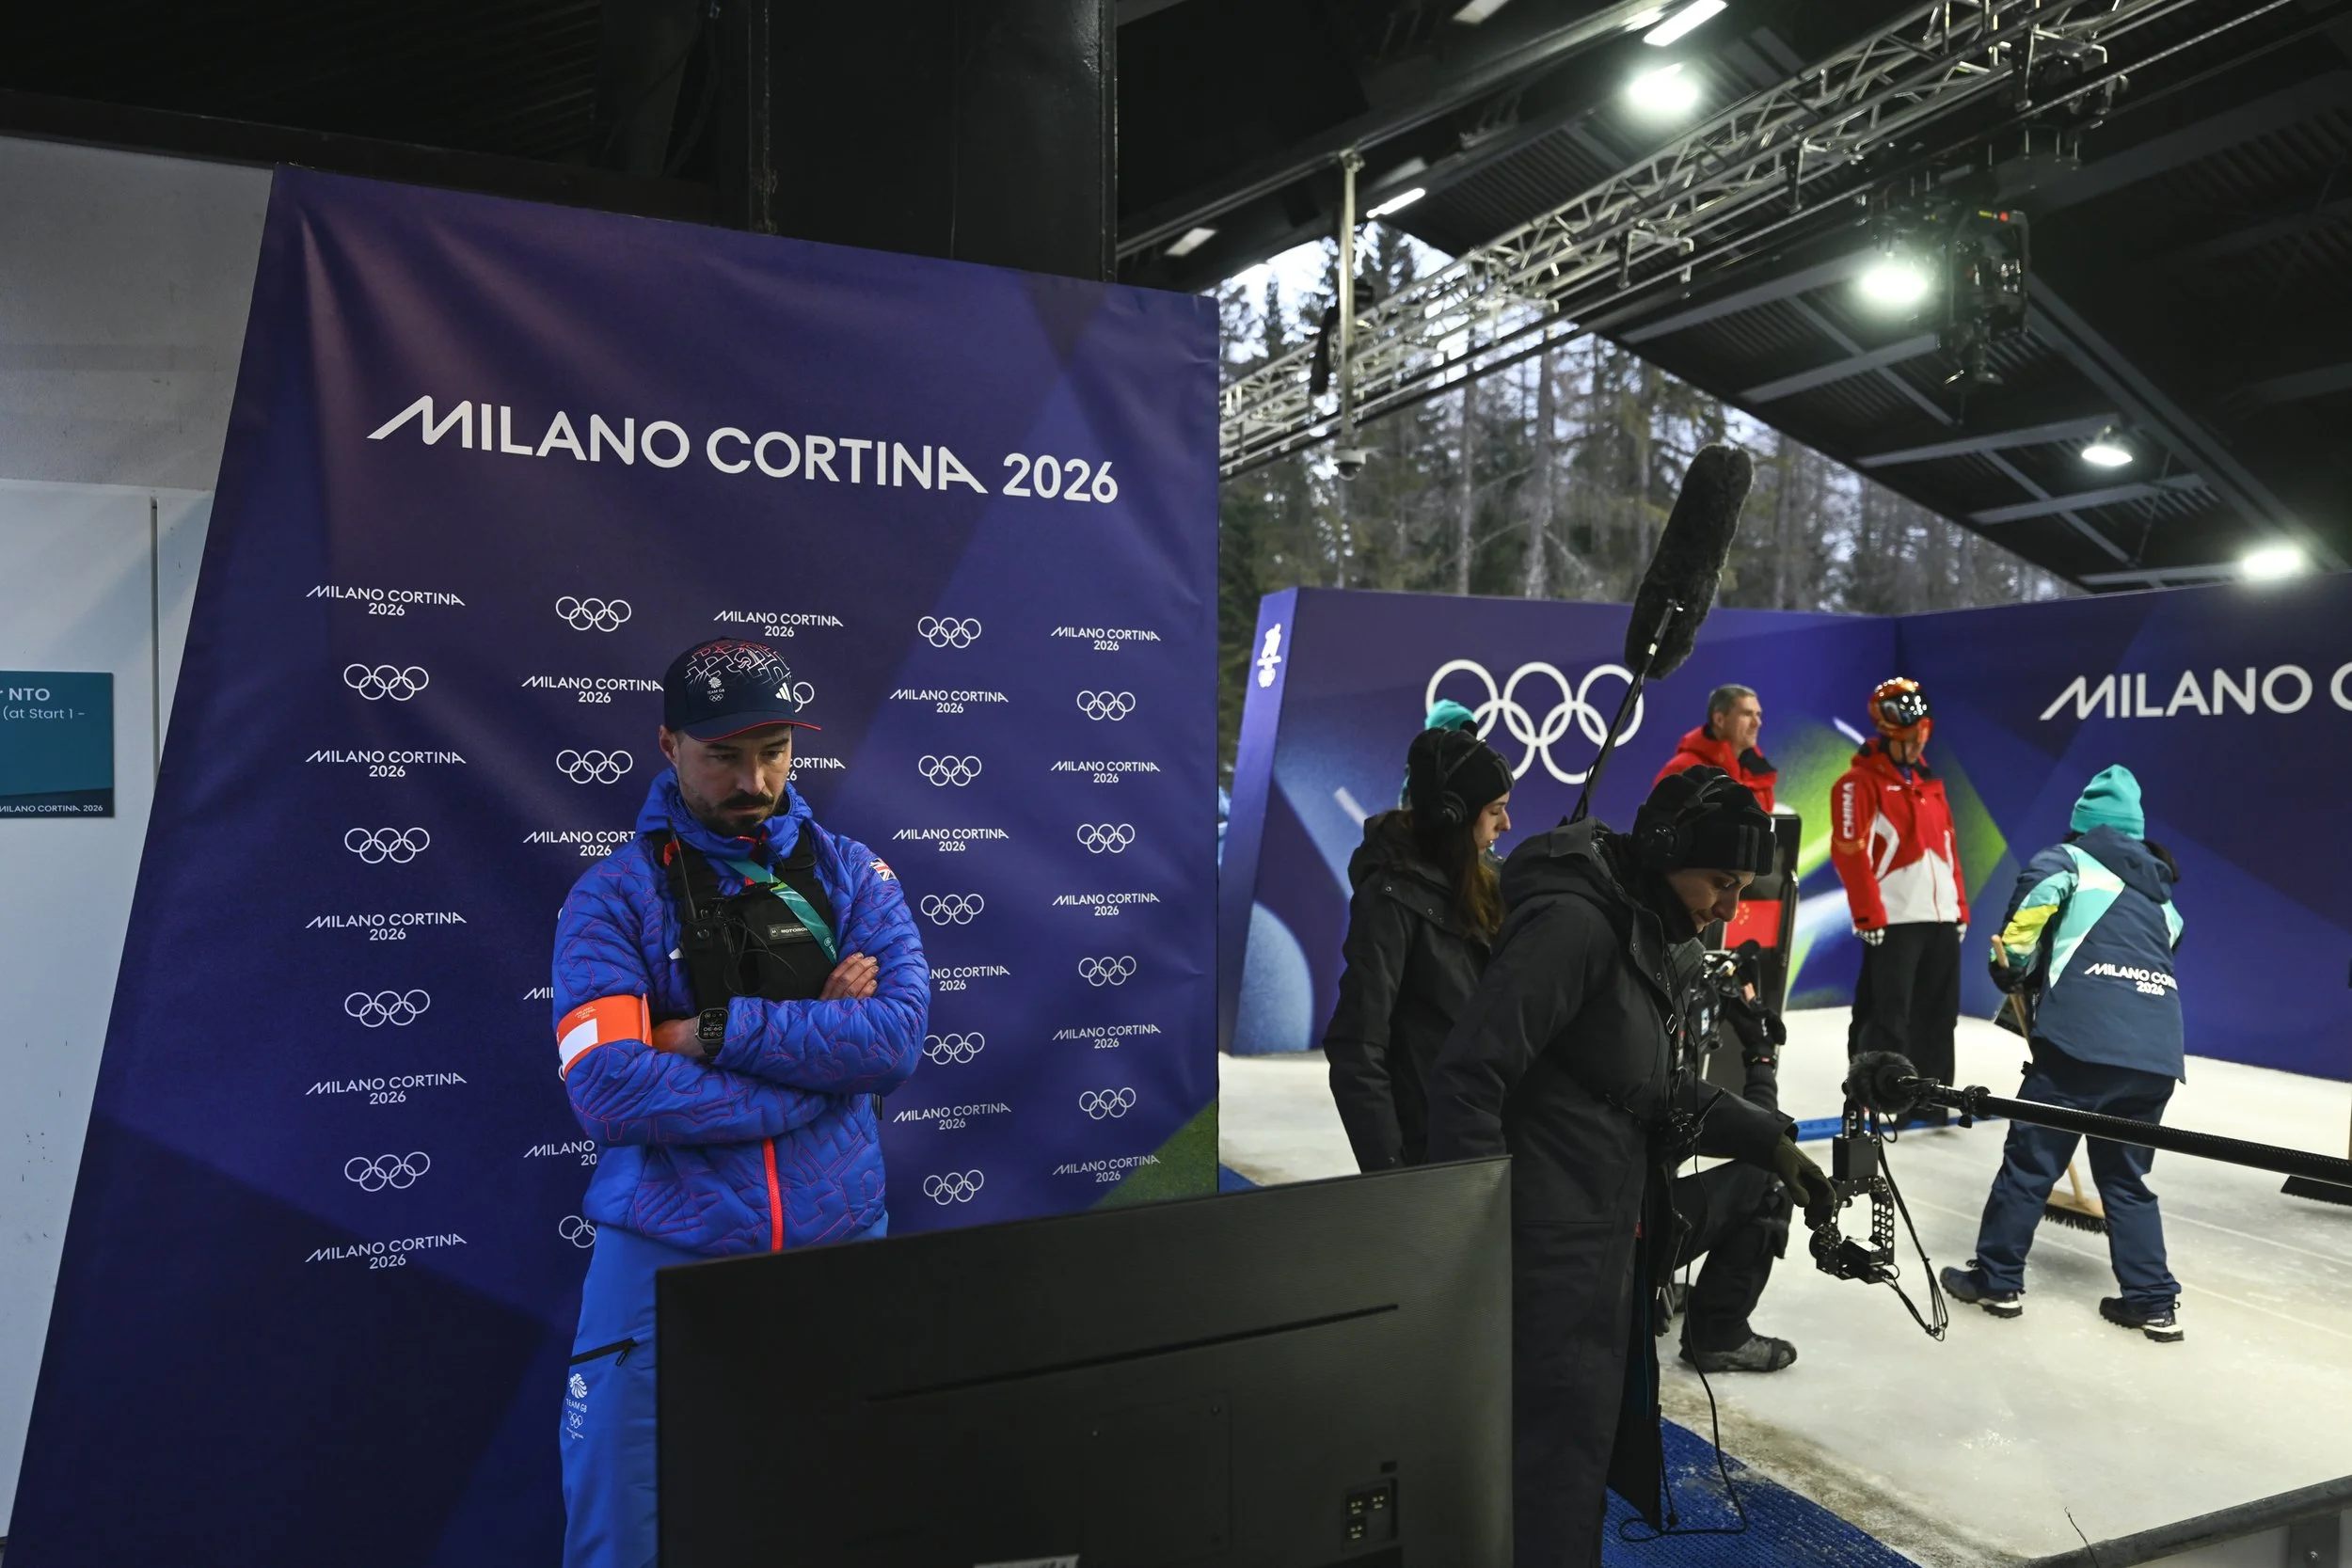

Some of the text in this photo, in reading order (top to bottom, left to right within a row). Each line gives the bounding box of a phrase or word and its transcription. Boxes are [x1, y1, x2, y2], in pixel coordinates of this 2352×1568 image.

[367, 395, 1119, 504] MILANO CORTINA 2026
[305, 585, 466, 607] MILANO CORTINA
[368, 602, 405, 617] 2026
[713, 610, 844, 627] MILANO CORTINA
[764, 625, 795, 638] 2026
[1050, 626, 1162, 641] MILANO CORTINA
[1093, 639, 1120, 652] 2026
[521, 675, 664, 692] MILANO CORTINA
[8, 688, 51, 702] NTO
[578, 690, 612, 704] 2026
[889, 689, 1009, 704] MILANO CORTINA
[2040, 664, 2313, 721] MILANO
[3, 705, 24, 721] (at
[29, 708, 64, 719] Start
[69, 708, 73, 719] 1
[936, 702, 964, 714] 2026
[305, 750, 467, 765] MILANO CORTINA
[790, 756, 847, 769] ORTINA
[369, 765, 406, 778] 2026
[1050, 760, 1161, 772] MILANO CORTINA
[1092, 772, 1120, 784] 2026
[37, 804, 81, 813] CORTINA
[83, 804, 103, 813] 2026
[1843, 782, 1855, 839] CHINA
[522, 831, 636, 844] MILANO CORT
[892, 828, 1009, 841] MILANO CORTINA
[579, 844, 612, 857] 2026
[938, 840, 966, 852] 2026
[1051, 892, 1161, 907] MILANO CORTINA
[1093, 905, 1120, 917] 2026
[305, 911, 468, 929] MILANO CORTINA
[369, 927, 406, 942] 2026
[952, 965, 1011, 979] CORTINA
[2084, 962, 2151, 982] MILANO
[939, 979, 967, 991] 2026
[2136, 980, 2166, 996] 2026
[1052, 1023, 1162, 1041] MILANO CORTINA
[1093, 1037, 1120, 1050] 2026
[305, 1072, 468, 1096] MILANO CORTINA
[369, 1090, 406, 1105] 2026
[892, 1102, 1011, 1123] MILANO CORTINA
[939, 1117, 966, 1131] 2026
[523, 1139, 596, 1158] MILANO
[1053, 1154, 1161, 1176] MILANO CORTINA
[1095, 1170, 1121, 1183] 2026
[305, 1233, 468, 1263] MILANO CORTINA
[369, 1253, 406, 1270] 2026
[566, 1399, 580, 1409] TEAM
